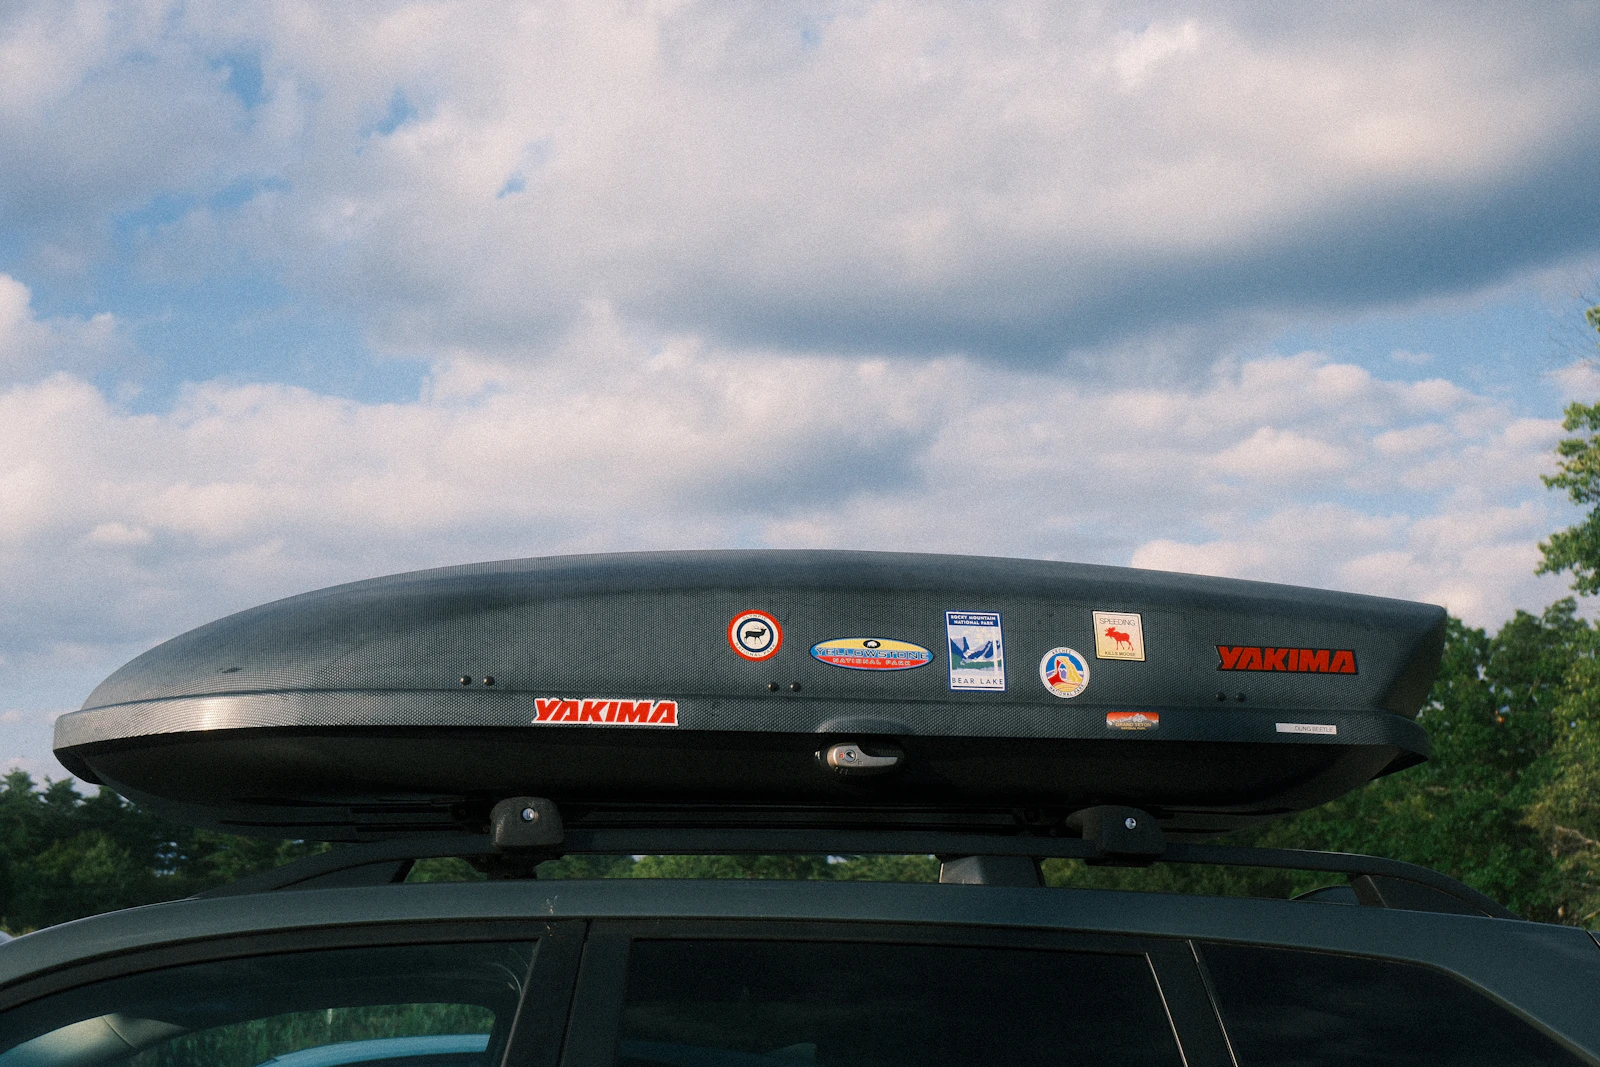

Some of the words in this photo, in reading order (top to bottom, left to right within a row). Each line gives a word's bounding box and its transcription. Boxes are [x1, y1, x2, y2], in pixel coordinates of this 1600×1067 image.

[1100, 618, 1136, 626] SPEEDING
[735, 642, 762, 656] NATIONAL
[763, 644, 776, 655] PARK
[816, 647, 929, 660] YELLOWSTONE
[1217, 645, 1356, 674] YAKIMA
[534, 698, 677, 724] YAKIMA
